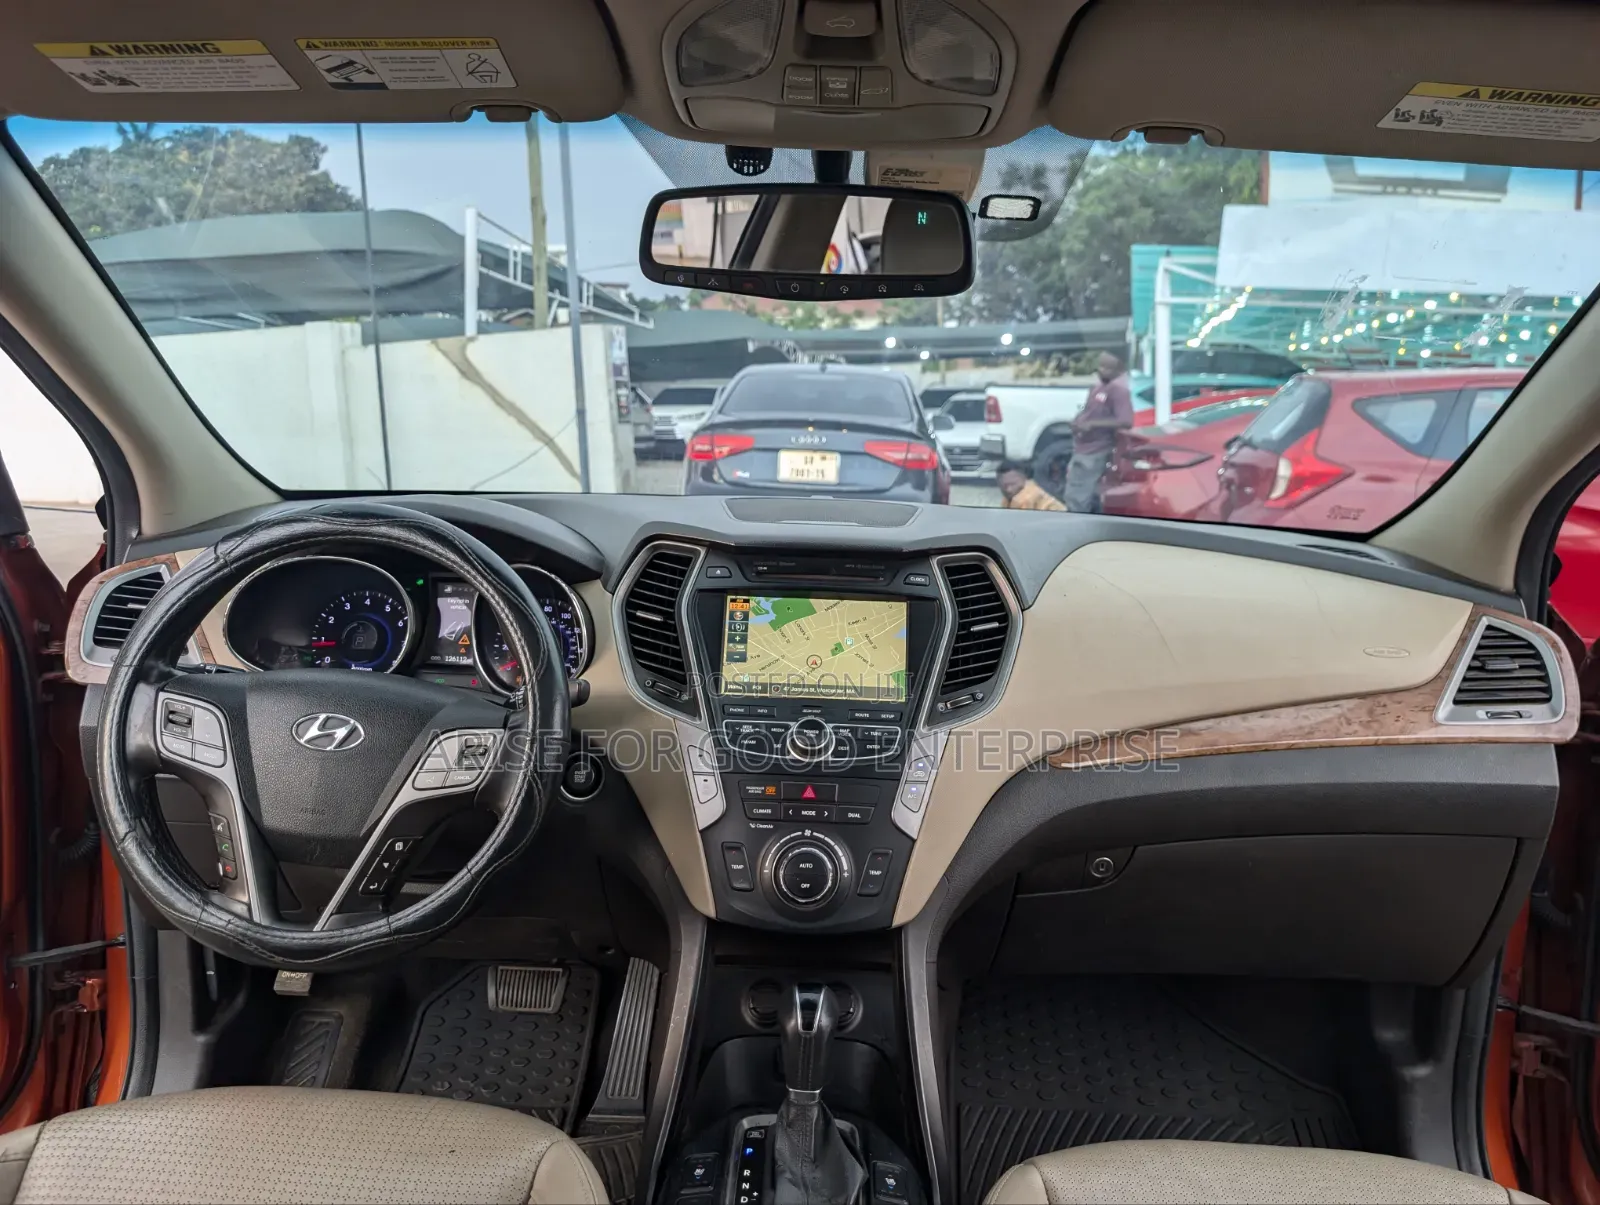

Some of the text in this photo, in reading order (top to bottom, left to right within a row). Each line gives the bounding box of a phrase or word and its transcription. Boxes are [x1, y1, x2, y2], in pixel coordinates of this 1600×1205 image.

[107, 43, 222, 55] WARNING
[1487, 89, 1600, 107] WARNING
[917, 211, 927, 225] N
[344, 602, 351, 610] 3
[364, 598, 371, 606] 4
[386, 604, 391, 612] 5
[328, 616, 335, 624] 2
[324, 656, 331, 664] 0
[746, 1147, 753, 1156] P
[742, 1182, 750, 1190] N
[740, 1196, 749, 1204] D
